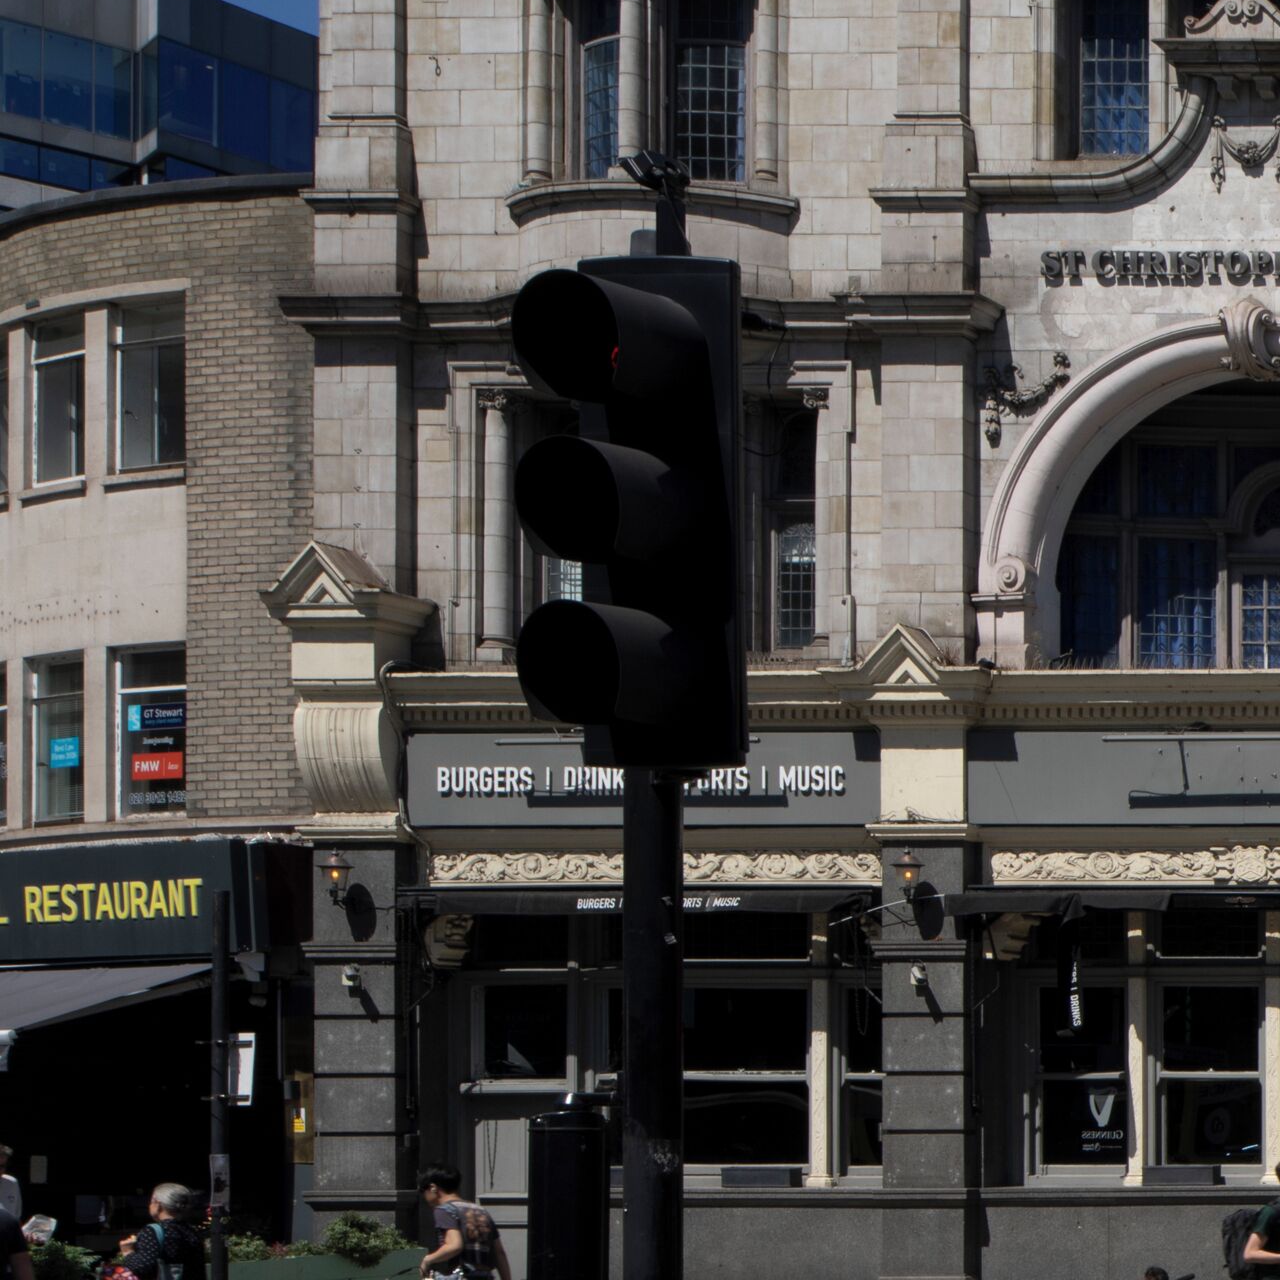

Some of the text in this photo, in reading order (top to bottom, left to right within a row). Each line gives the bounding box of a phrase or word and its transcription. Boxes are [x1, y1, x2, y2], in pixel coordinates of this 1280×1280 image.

[1040, 250, 1086, 278] ST
[155, 708, 184, 718] Stewart
[134, 761, 160, 772] FMW
[437, 766, 532, 792] BURGERS
[564, 766, 624, 790] DRINK
[779, 765, 844, 791] MUSIC
[24, 878, 202, 923] RESTAURANT
[577, 898, 616, 909] BURGERS
[712, 897, 741, 908] MUSIC
[1070, 994, 1081, 1027] DRINKS
